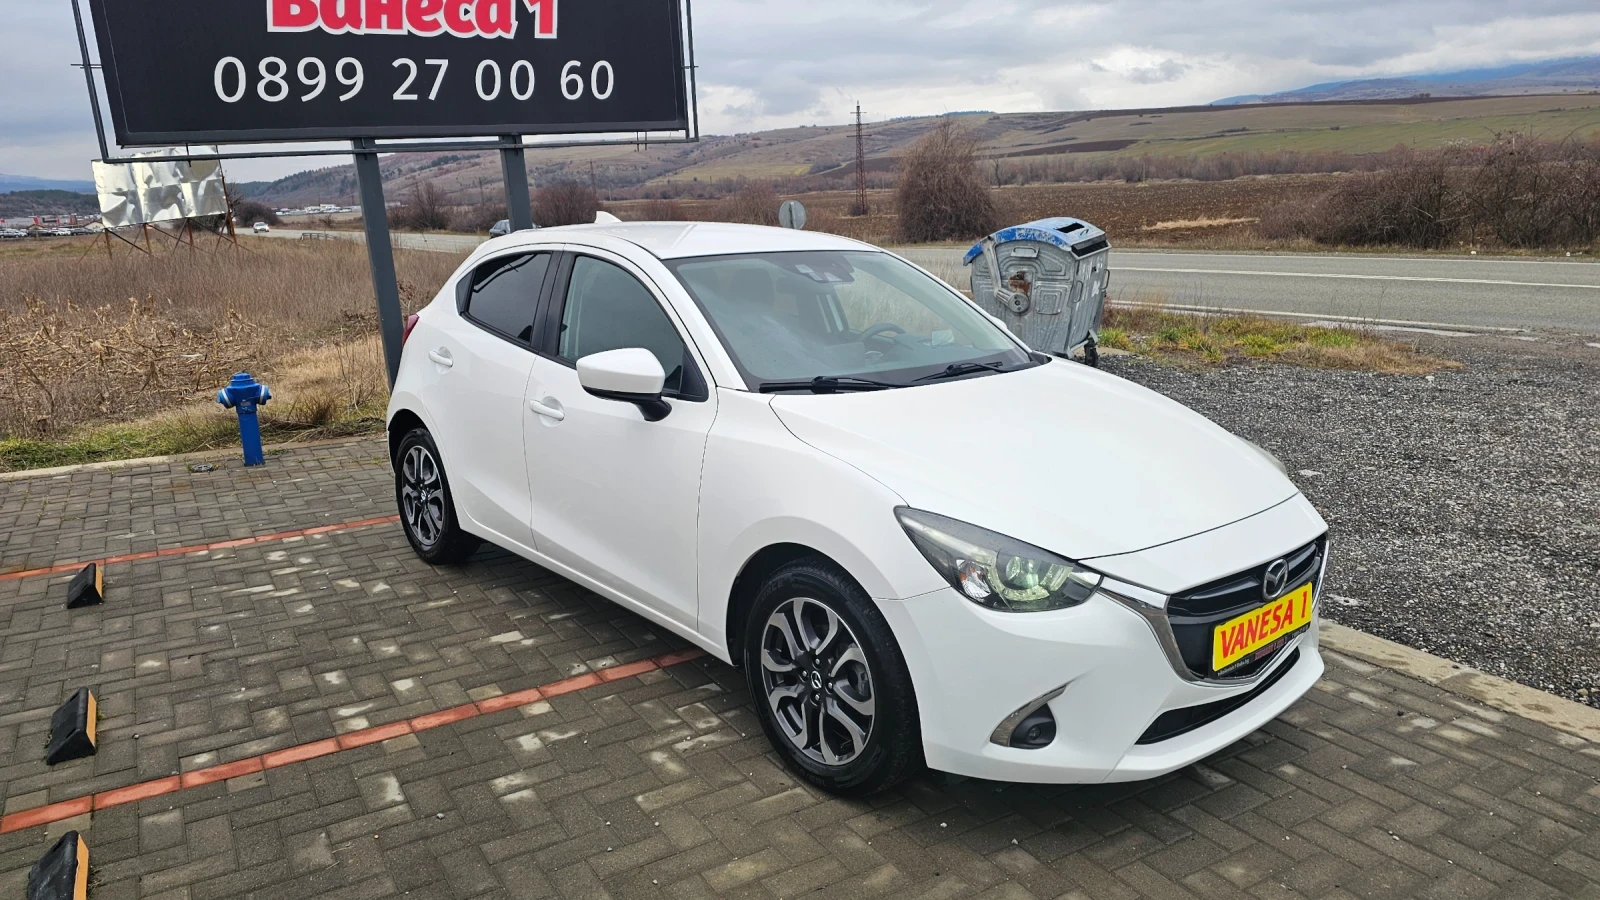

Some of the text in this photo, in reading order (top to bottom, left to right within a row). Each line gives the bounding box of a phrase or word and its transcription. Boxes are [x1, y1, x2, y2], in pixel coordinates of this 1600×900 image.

[523, 0, 558, 39] 1
[213, 55, 615, 103] 0899 27 00 60
[1220, 598, 1293, 659] VANESA
